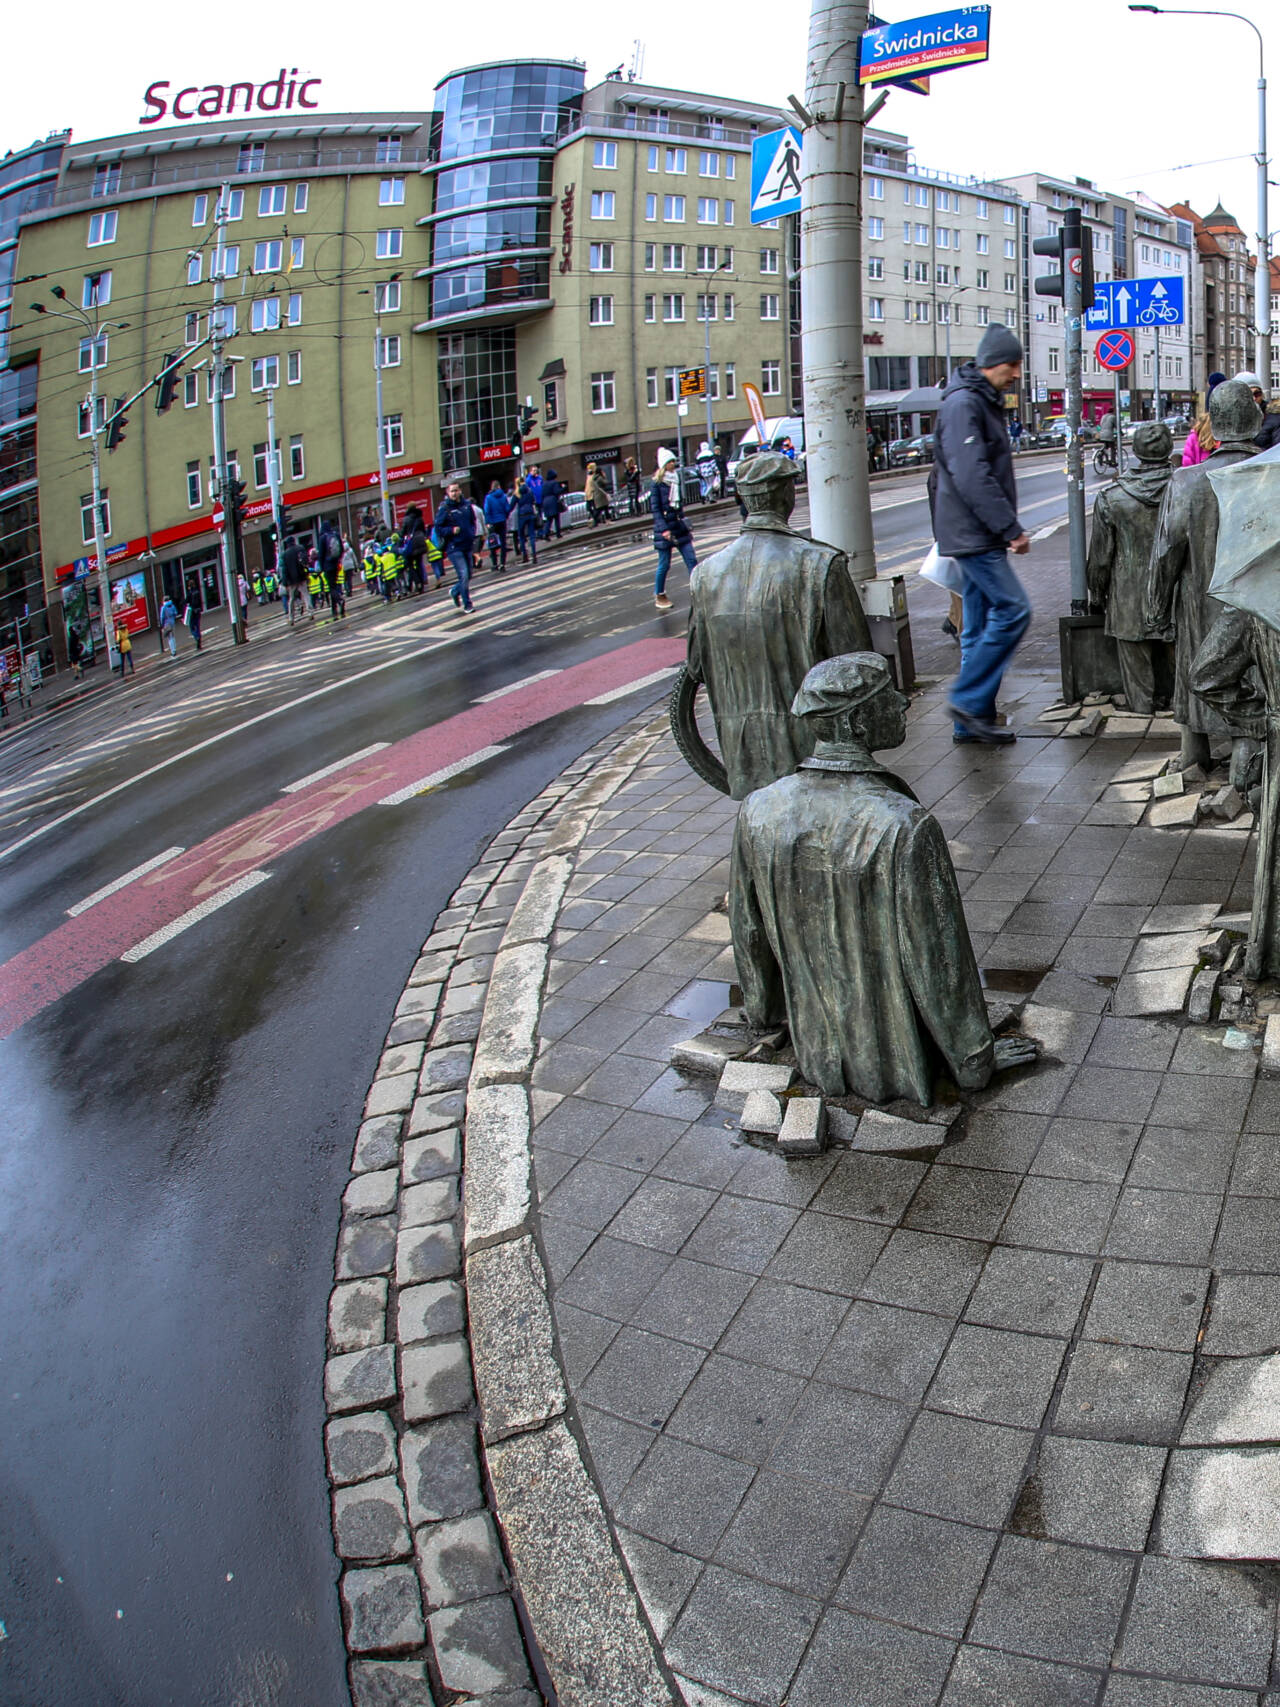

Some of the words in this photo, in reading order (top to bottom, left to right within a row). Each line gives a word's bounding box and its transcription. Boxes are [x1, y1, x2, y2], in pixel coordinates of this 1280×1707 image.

[873, 22, 979, 58] Świdnicka
[869, 55, 920, 74] Przedmieście
[921, 46, 967, 62] Świdnickie
[139, 68, 322, 125] Scandic
[559, 182, 576, 274] Scandic
[483, 447, 502, 460] AVIS
